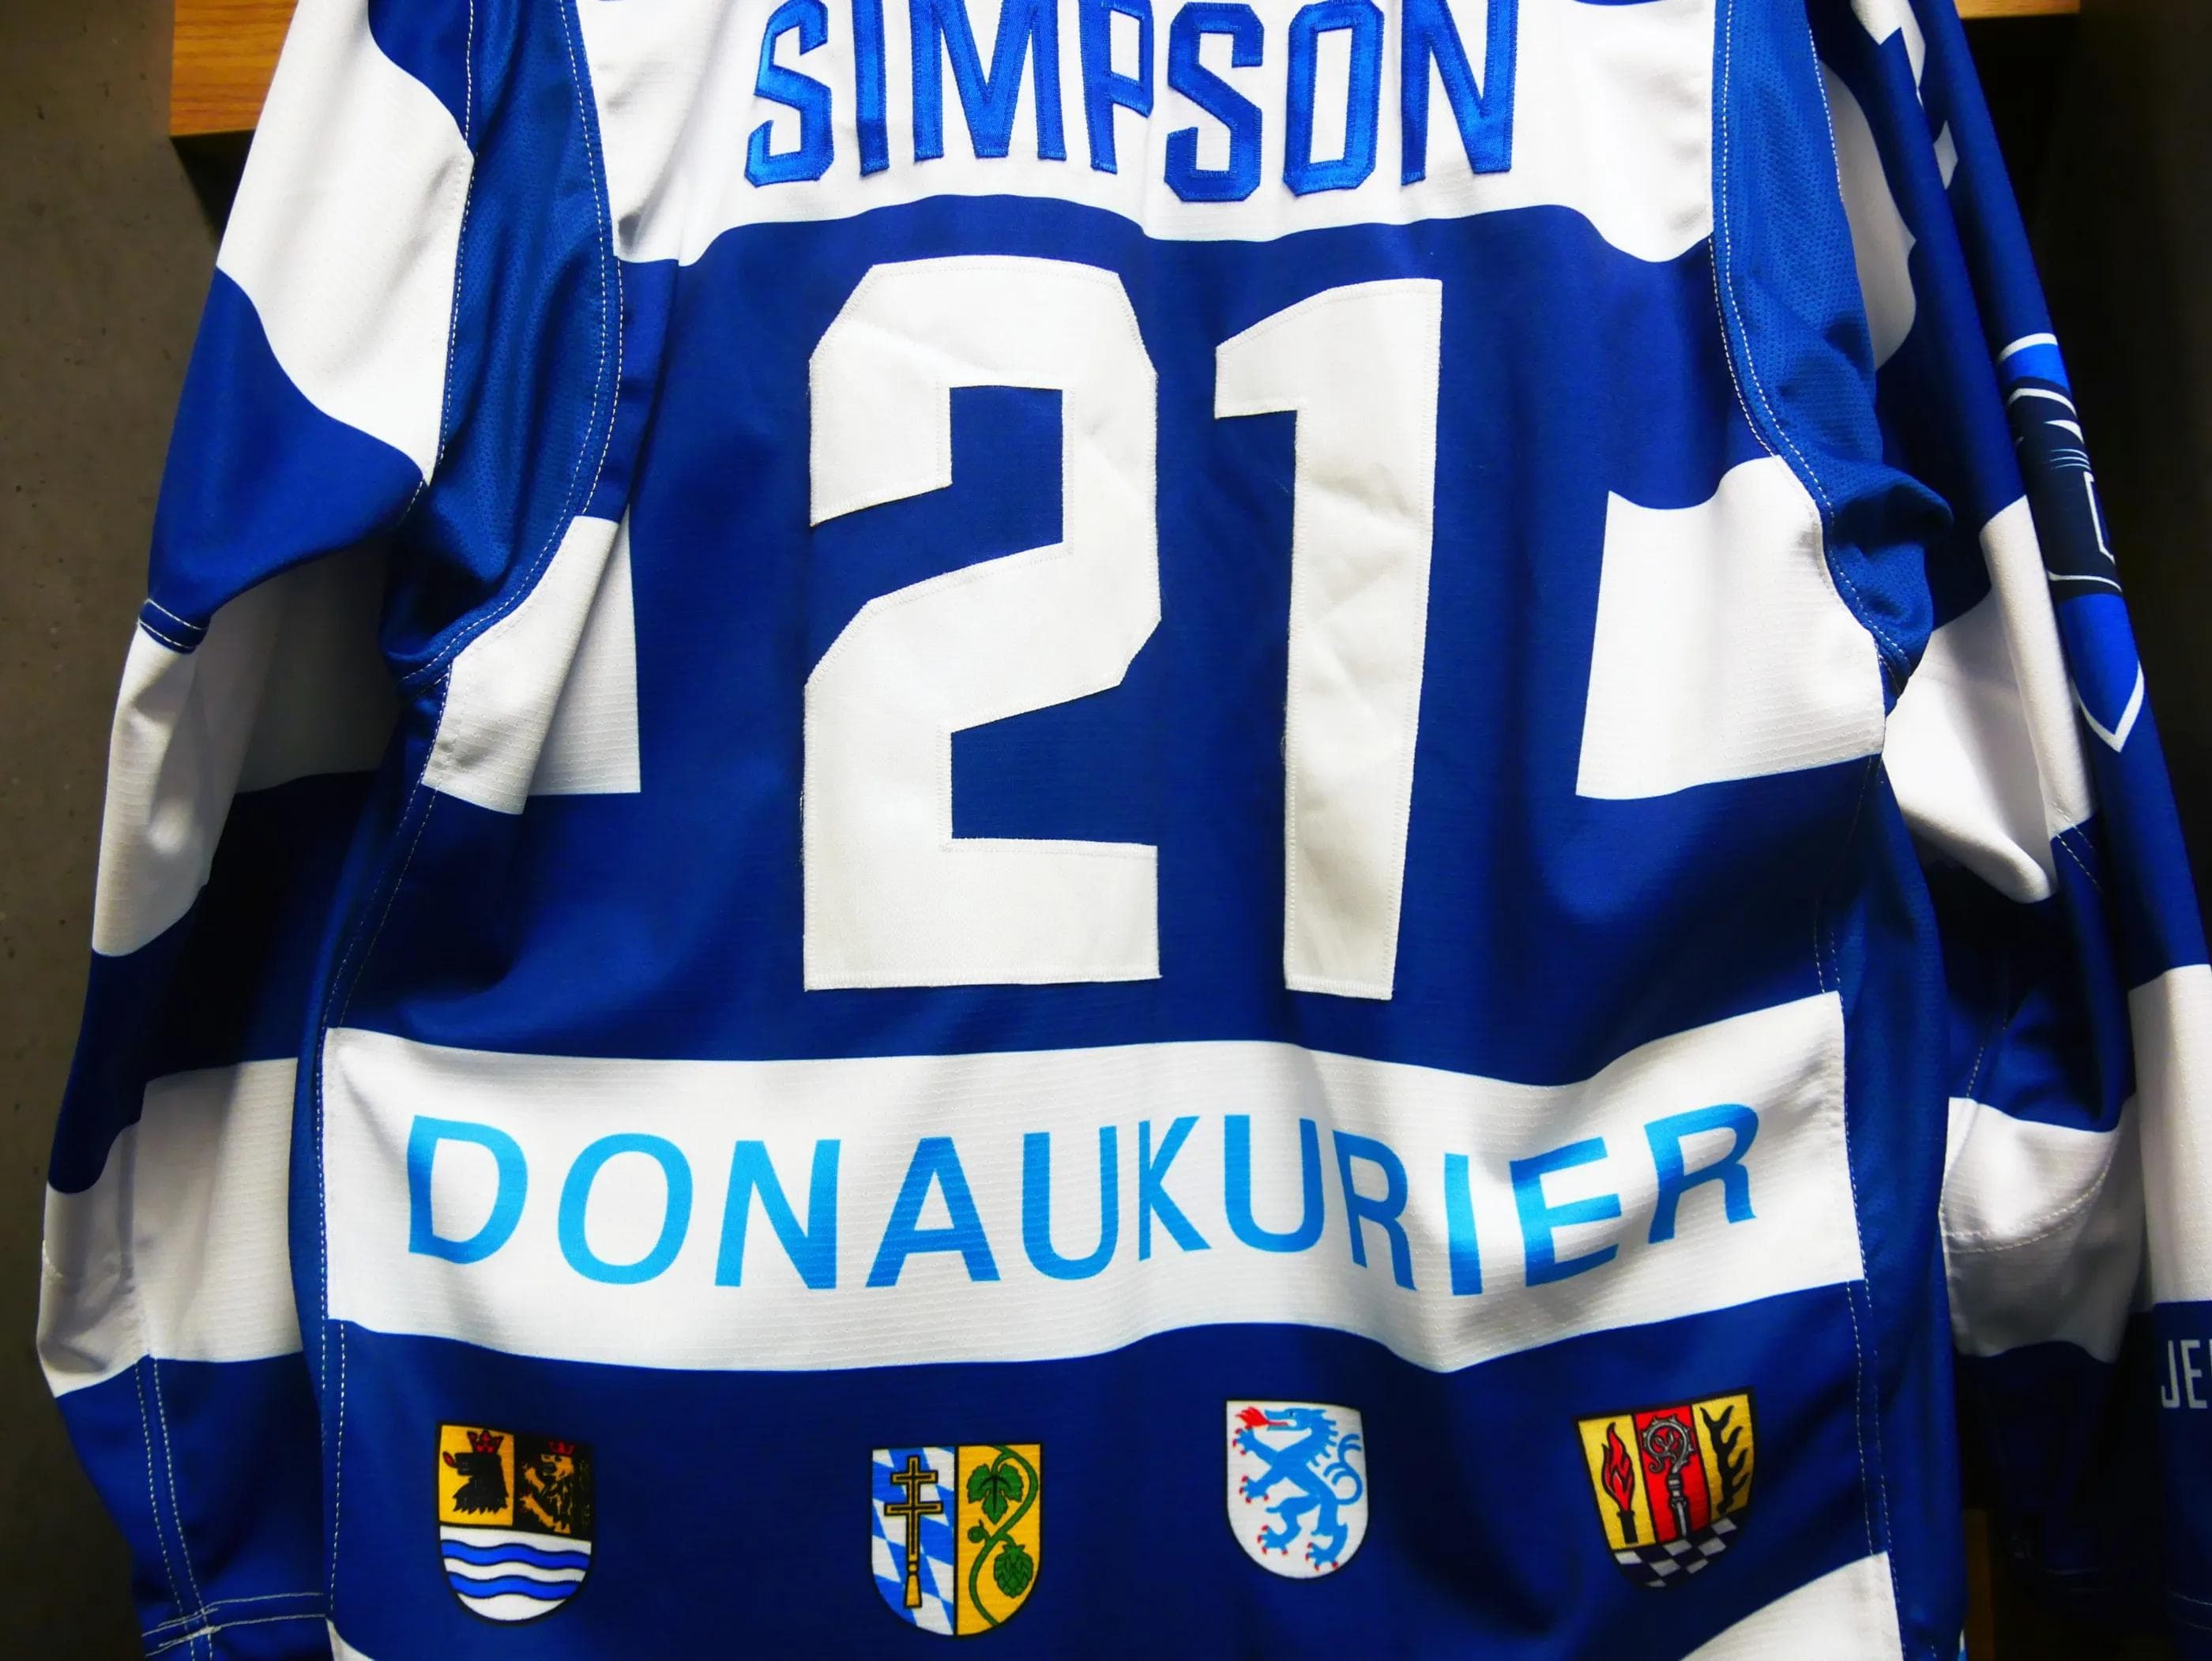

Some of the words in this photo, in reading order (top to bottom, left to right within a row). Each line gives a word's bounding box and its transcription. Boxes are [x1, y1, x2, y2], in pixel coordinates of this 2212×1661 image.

[744, 0, 1518, 202] SIMPSON
[803, 254, 1443, 1001] 21
[407, 1102, 1759, 1296] DONAUKURIER
[2161, 1338, 2212, 1409] JE
